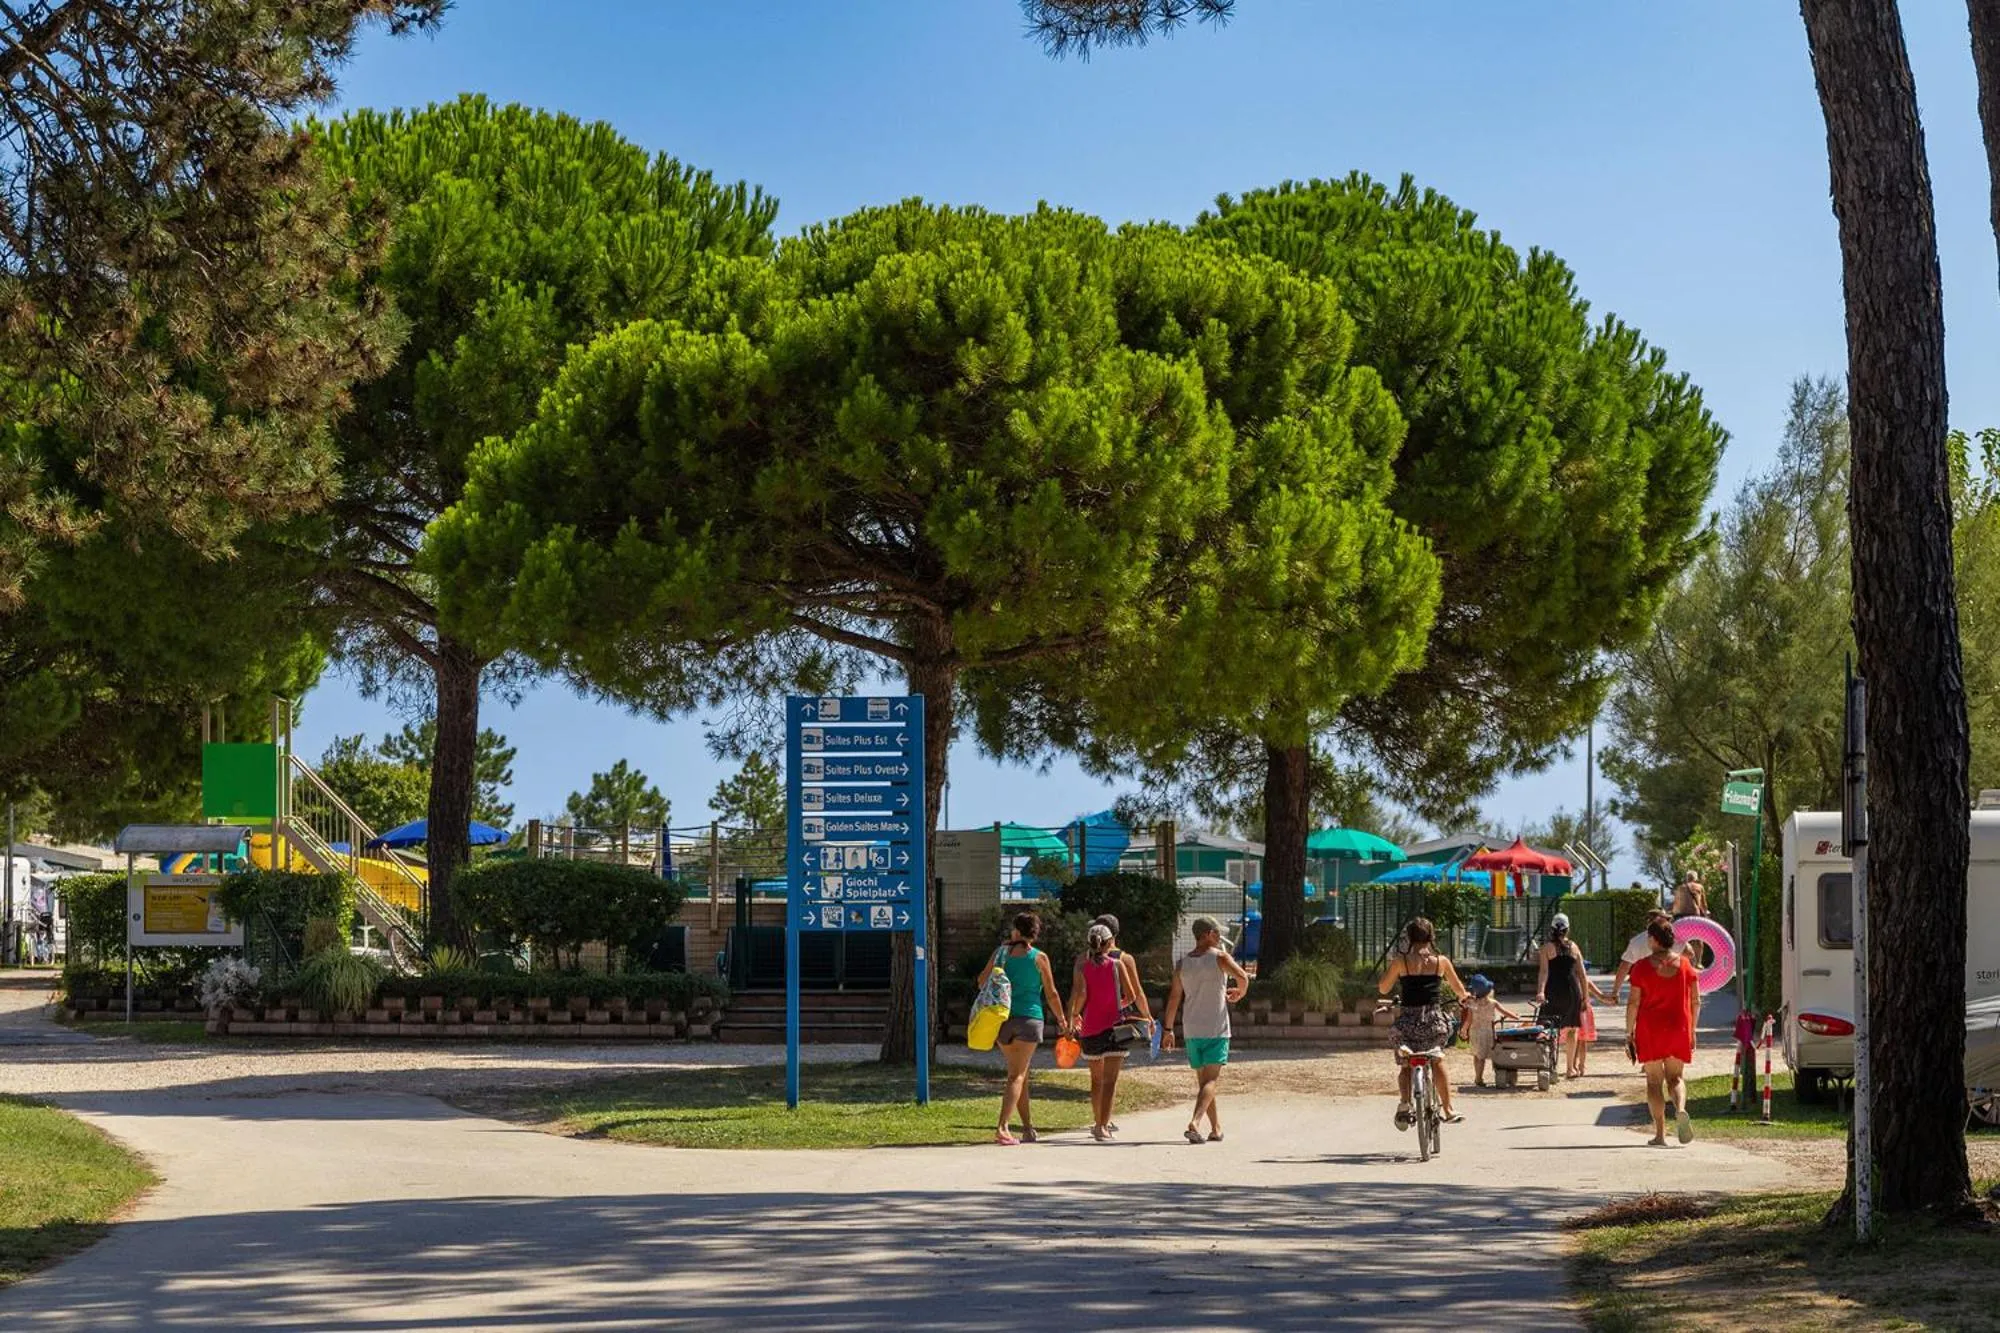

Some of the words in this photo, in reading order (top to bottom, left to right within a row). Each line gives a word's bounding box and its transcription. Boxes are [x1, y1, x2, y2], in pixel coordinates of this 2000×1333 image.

[825, 735, 851, 745] Suites
[854, 735, 872, 745] Plus
[874, 735, 888, 745] Est
[825, 765, 851, 775] Suites
[854, 765, 872, 775] Plus
[875, 765, 899, 775] Ovest
[825, 793, 851, 803] Suites
[854, 793, 882, 803] Deluxe
[826, 821, 853, 831] Golden
[855, 821, 879, 831] Suites
[881, 821, 900, 831] Mare
[846, 877, 877, 886] Giochi
[846, 888, 896, 899] Spielplatz
